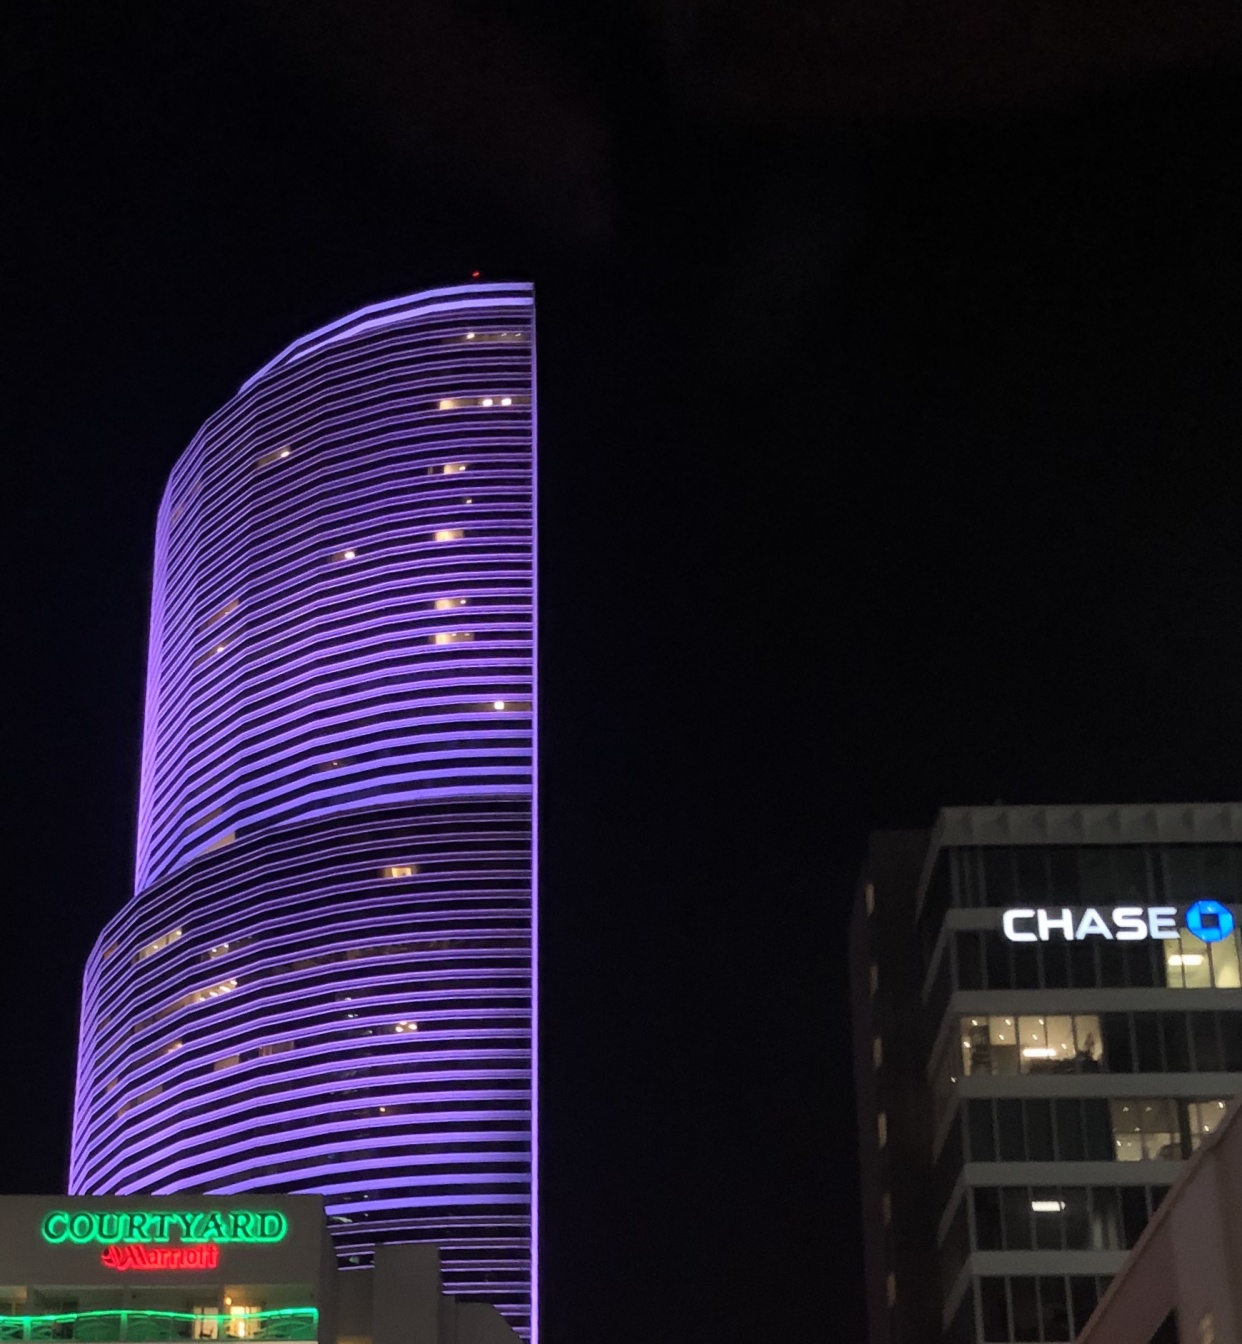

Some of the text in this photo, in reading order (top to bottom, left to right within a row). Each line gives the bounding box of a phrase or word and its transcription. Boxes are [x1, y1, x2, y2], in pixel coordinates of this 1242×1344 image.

[1002, 906, 1181, 942] CHASE
[43, 1211, 286, 1242] COURTYARD
[115, 1245, 219, 1270] Marriott
